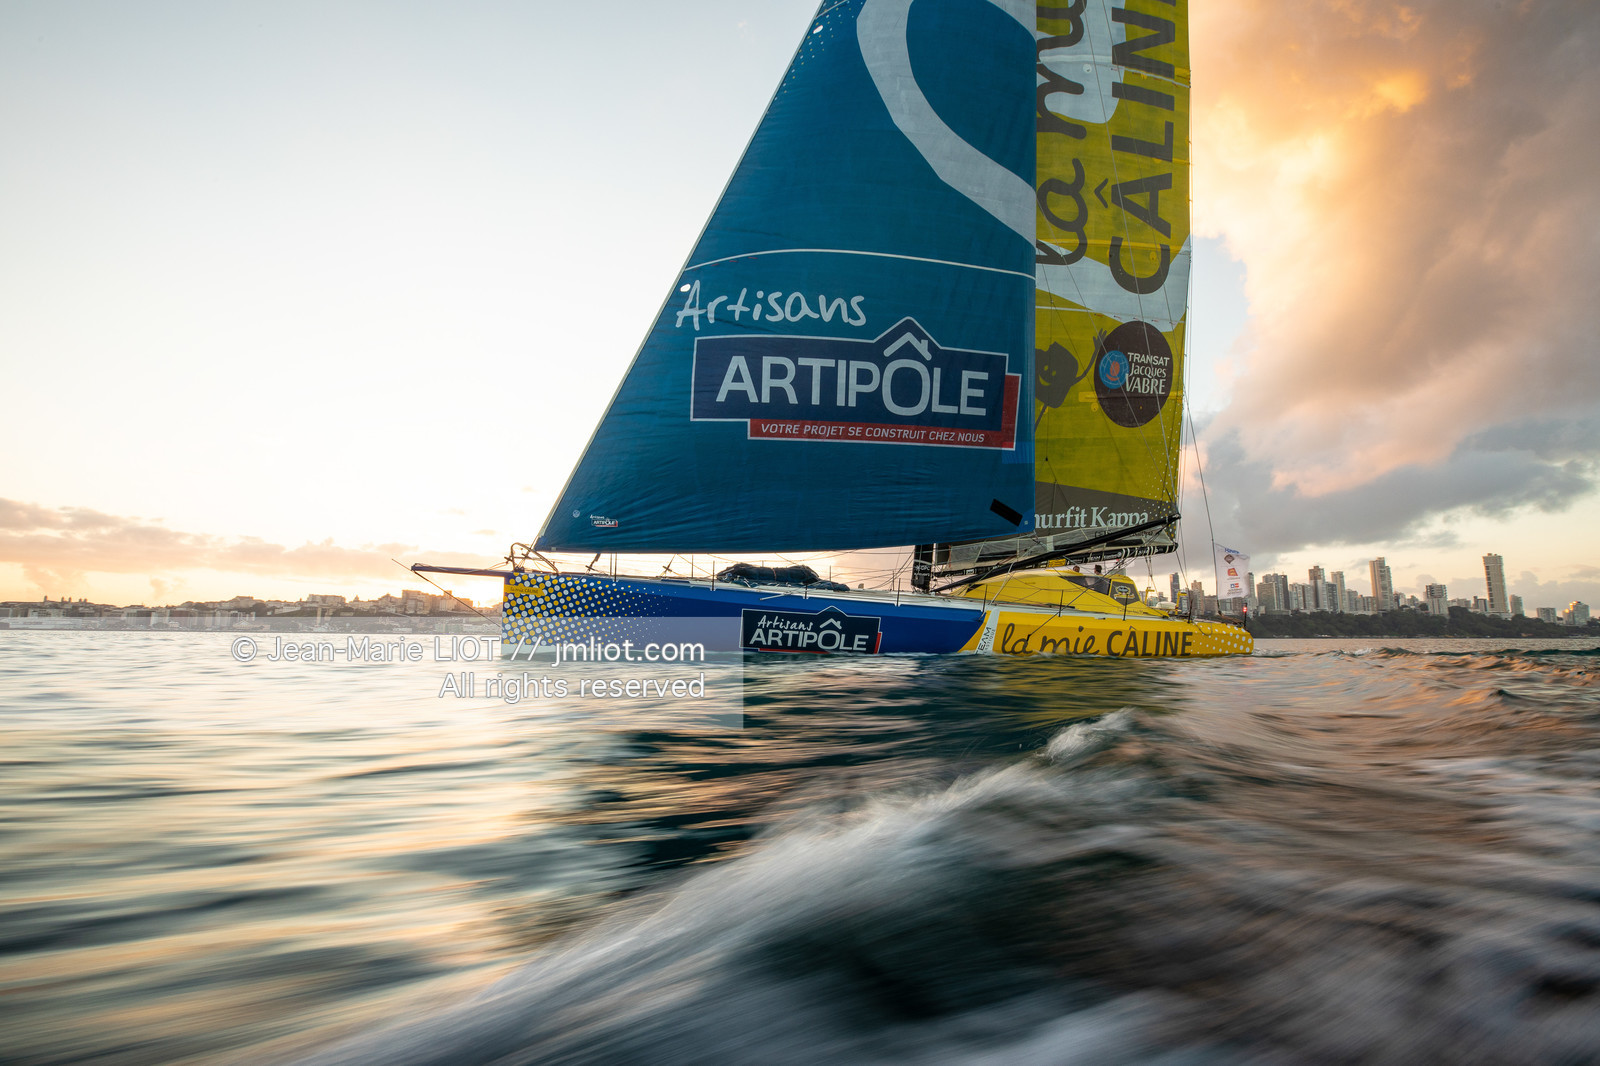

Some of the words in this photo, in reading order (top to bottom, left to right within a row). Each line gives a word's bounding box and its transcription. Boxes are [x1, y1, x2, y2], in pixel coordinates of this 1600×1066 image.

[1094, 0, 1176, 295] CÂLIN
[675, 280, 867, 331] Artisans
[1127, 352, 1170, 367] TRANSAT
[1129, 363, 1167, 378] Jacques
[715, 332, 988, 416] ARTIPÔLE
[1125, 373, 1166, 395] VABRE
[761, 423, 800, 435] VOTRE
[803, 424, 845, 437] PROJET
[847, 426, 862, 437] SE
[865, 427, 926, 440] CONSTRUIT
[928, 430, 955, 442] CHEZ
[957, 432, 985, 443] NOUS
[1090, 506, 1149, 528] Kappa
[757, 614, 813, 631] Artisans
[749, 618, 869, 651] ARTIPÔLE
[1001, 622, 1033, 655] la
[1041, 626, 1099, 656] mie
[1106, 625, 1193, 657] CÂLINE
